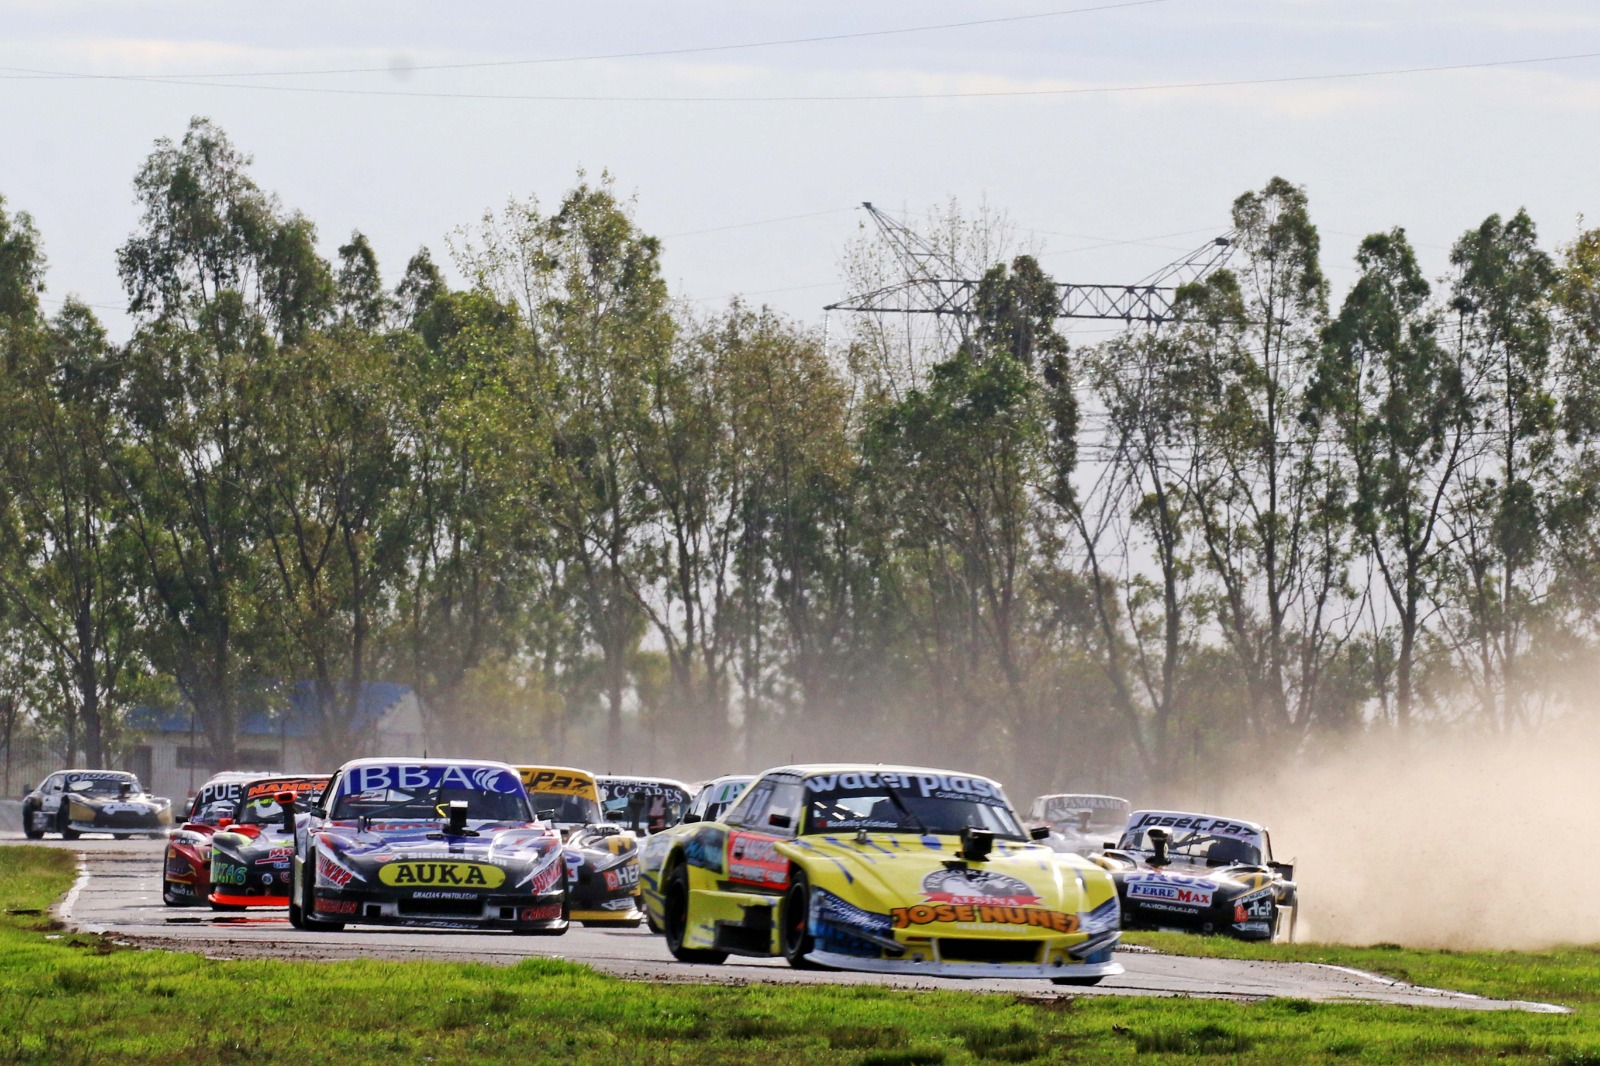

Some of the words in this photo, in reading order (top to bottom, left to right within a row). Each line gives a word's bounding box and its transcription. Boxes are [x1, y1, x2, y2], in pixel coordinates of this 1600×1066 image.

[394, 864, 487, 885] AUKA
[951, 896, 1019, 907] ALSINA
[890, 904, 976, 929] JOSE
